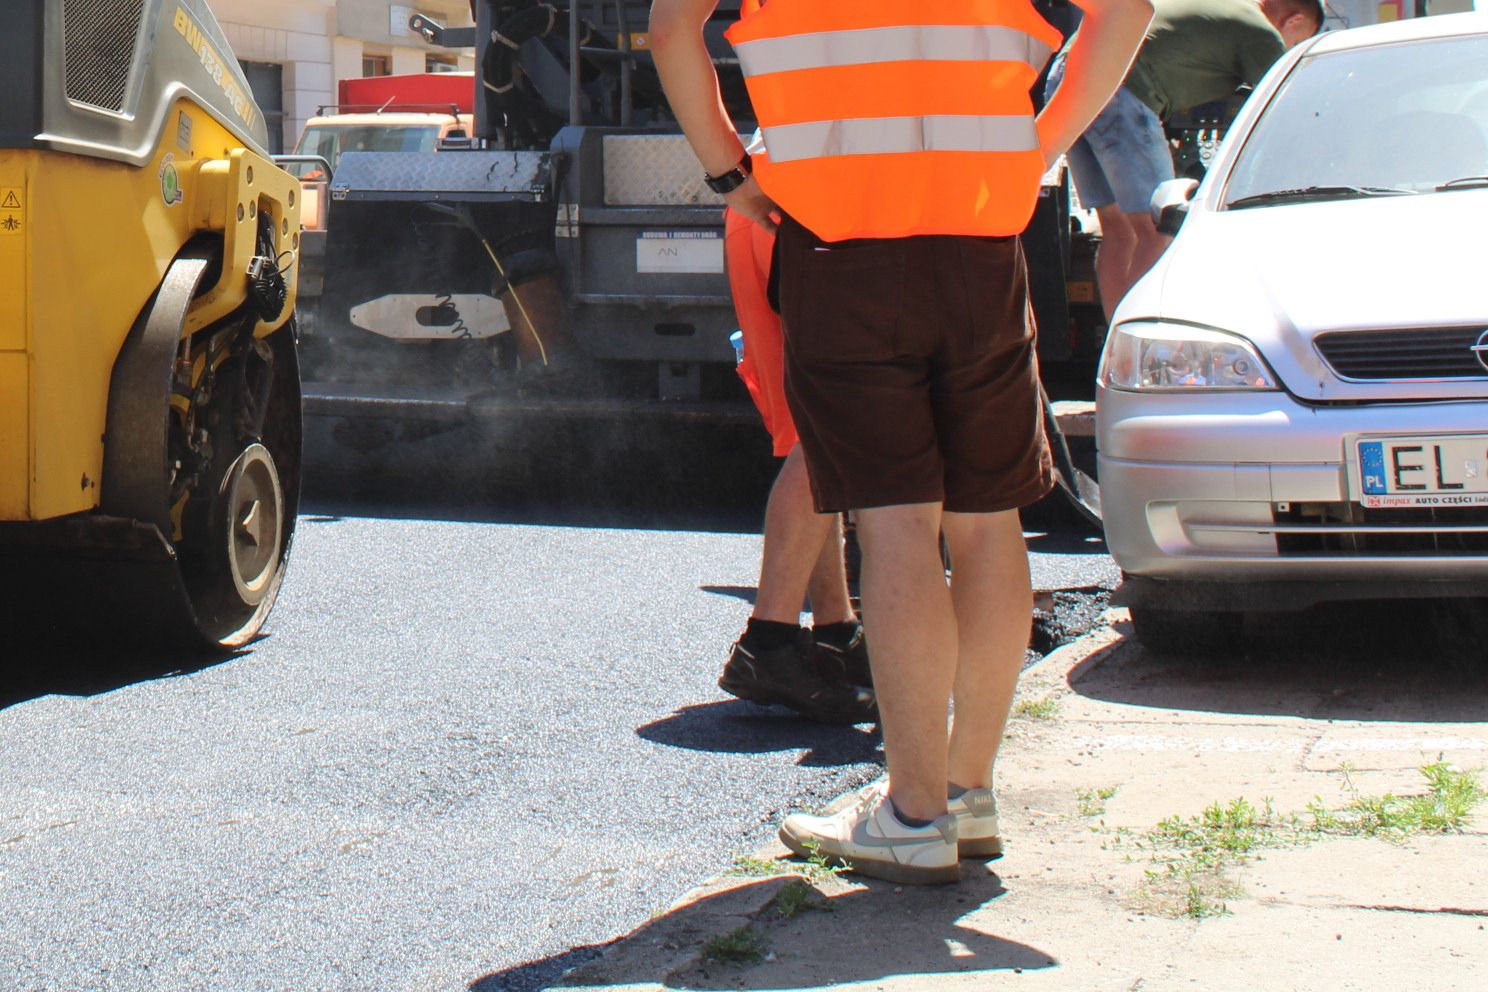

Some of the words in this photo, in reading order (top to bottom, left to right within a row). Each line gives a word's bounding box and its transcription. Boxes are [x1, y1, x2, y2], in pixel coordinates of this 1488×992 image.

[173, 6, 205, 57] BW
[1365, 475, 1384, 488] PL
[1392, 445, 1464, 490] EL
[1383, 496, 1411, 506] impax
[1442, 495, 1472, 505] CZĘŚCI
